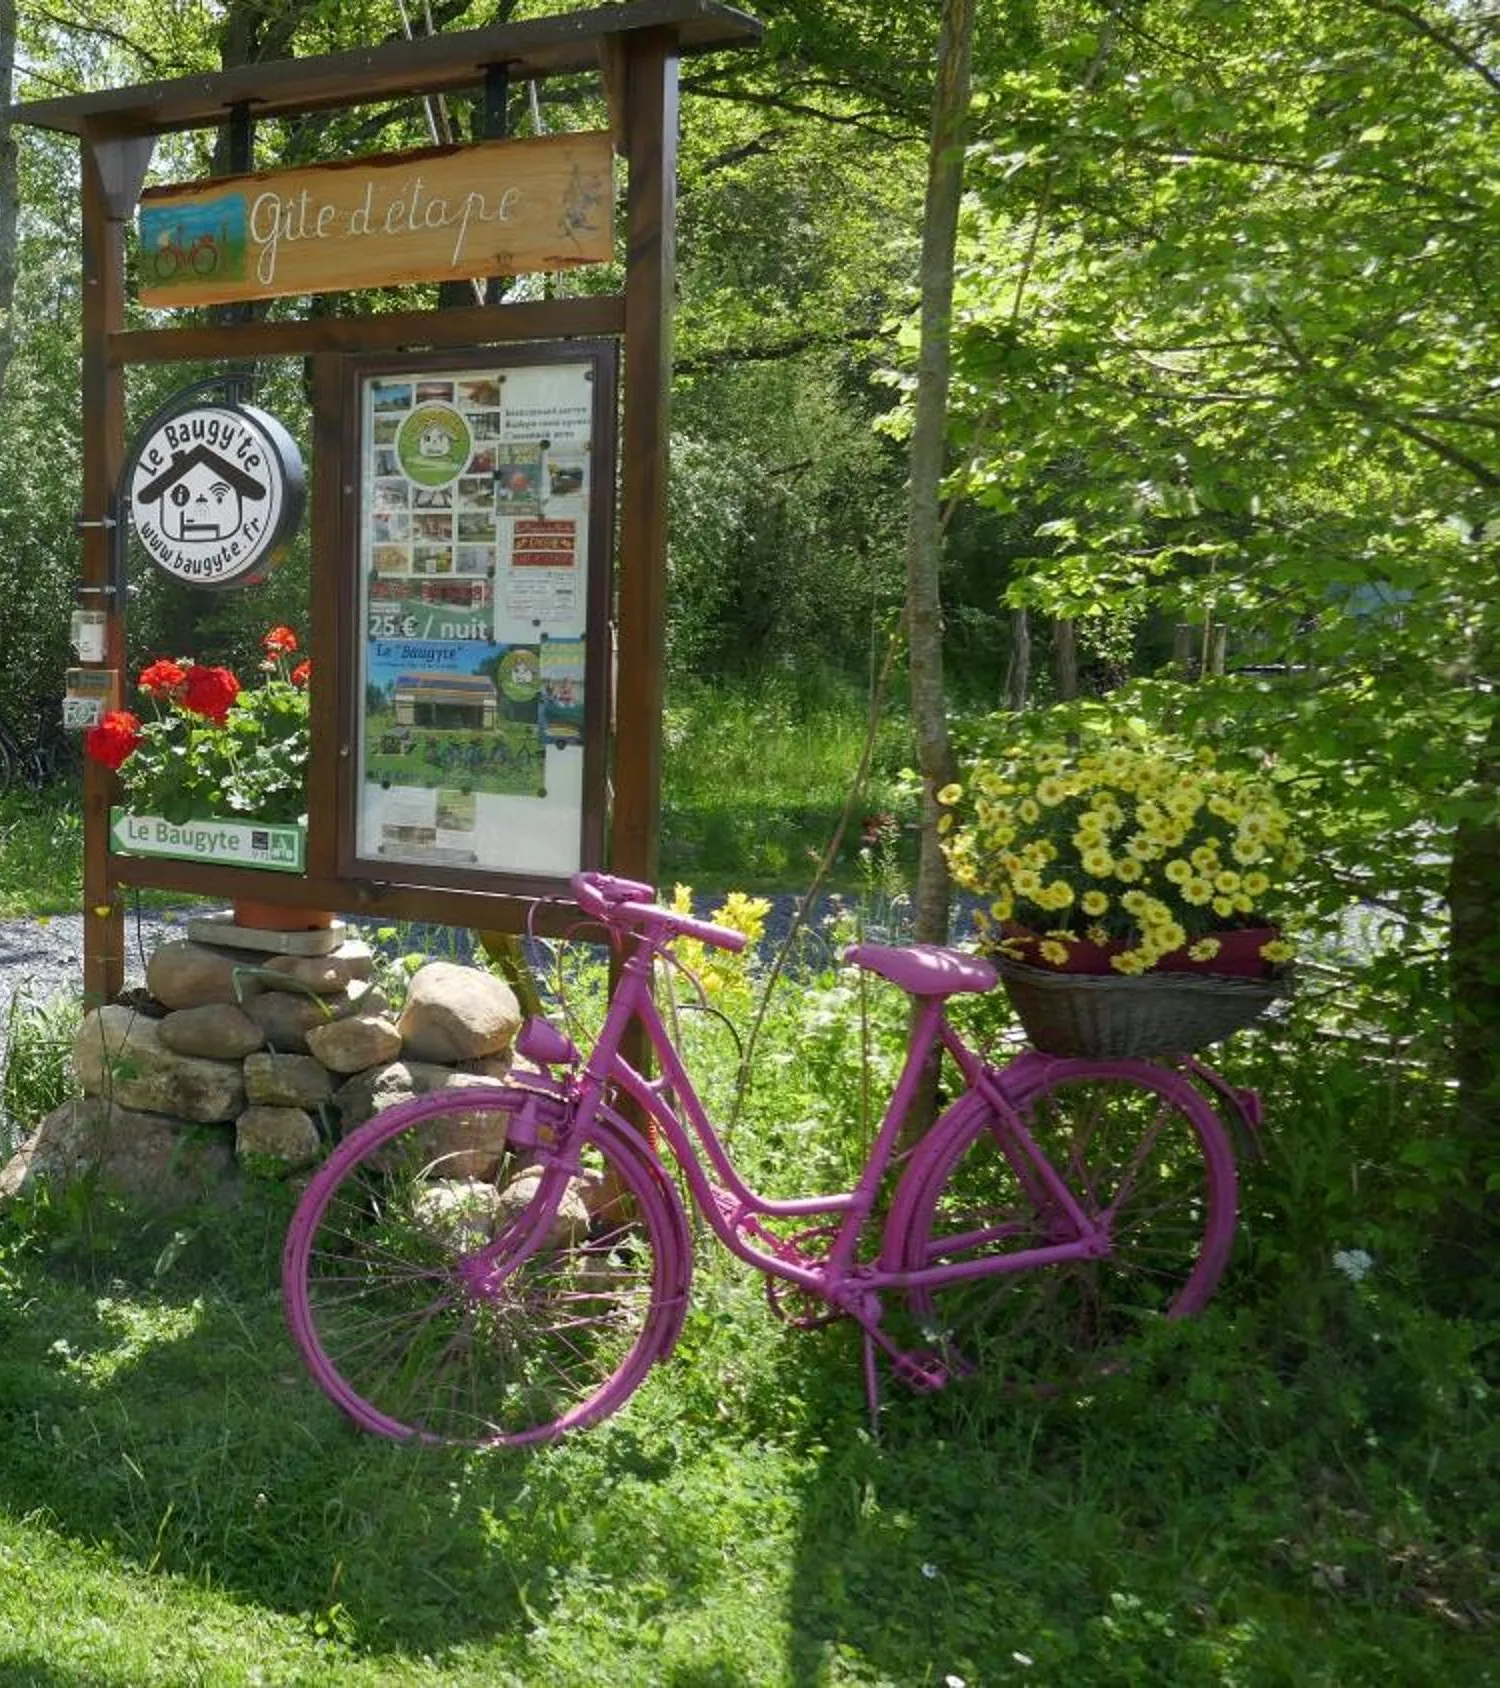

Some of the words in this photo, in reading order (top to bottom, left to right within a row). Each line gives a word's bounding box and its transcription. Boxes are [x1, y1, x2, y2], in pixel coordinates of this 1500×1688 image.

[138, 447, 164, 477] Le
[164, 418, 261, 473] Baugy'te
[140, 517, 261, 576] www.baugyte.fr
[440, 618, 489, 640] nuit
[128, 818, 149, 842] Le
[155, 823, 241, 853] Baugyte
